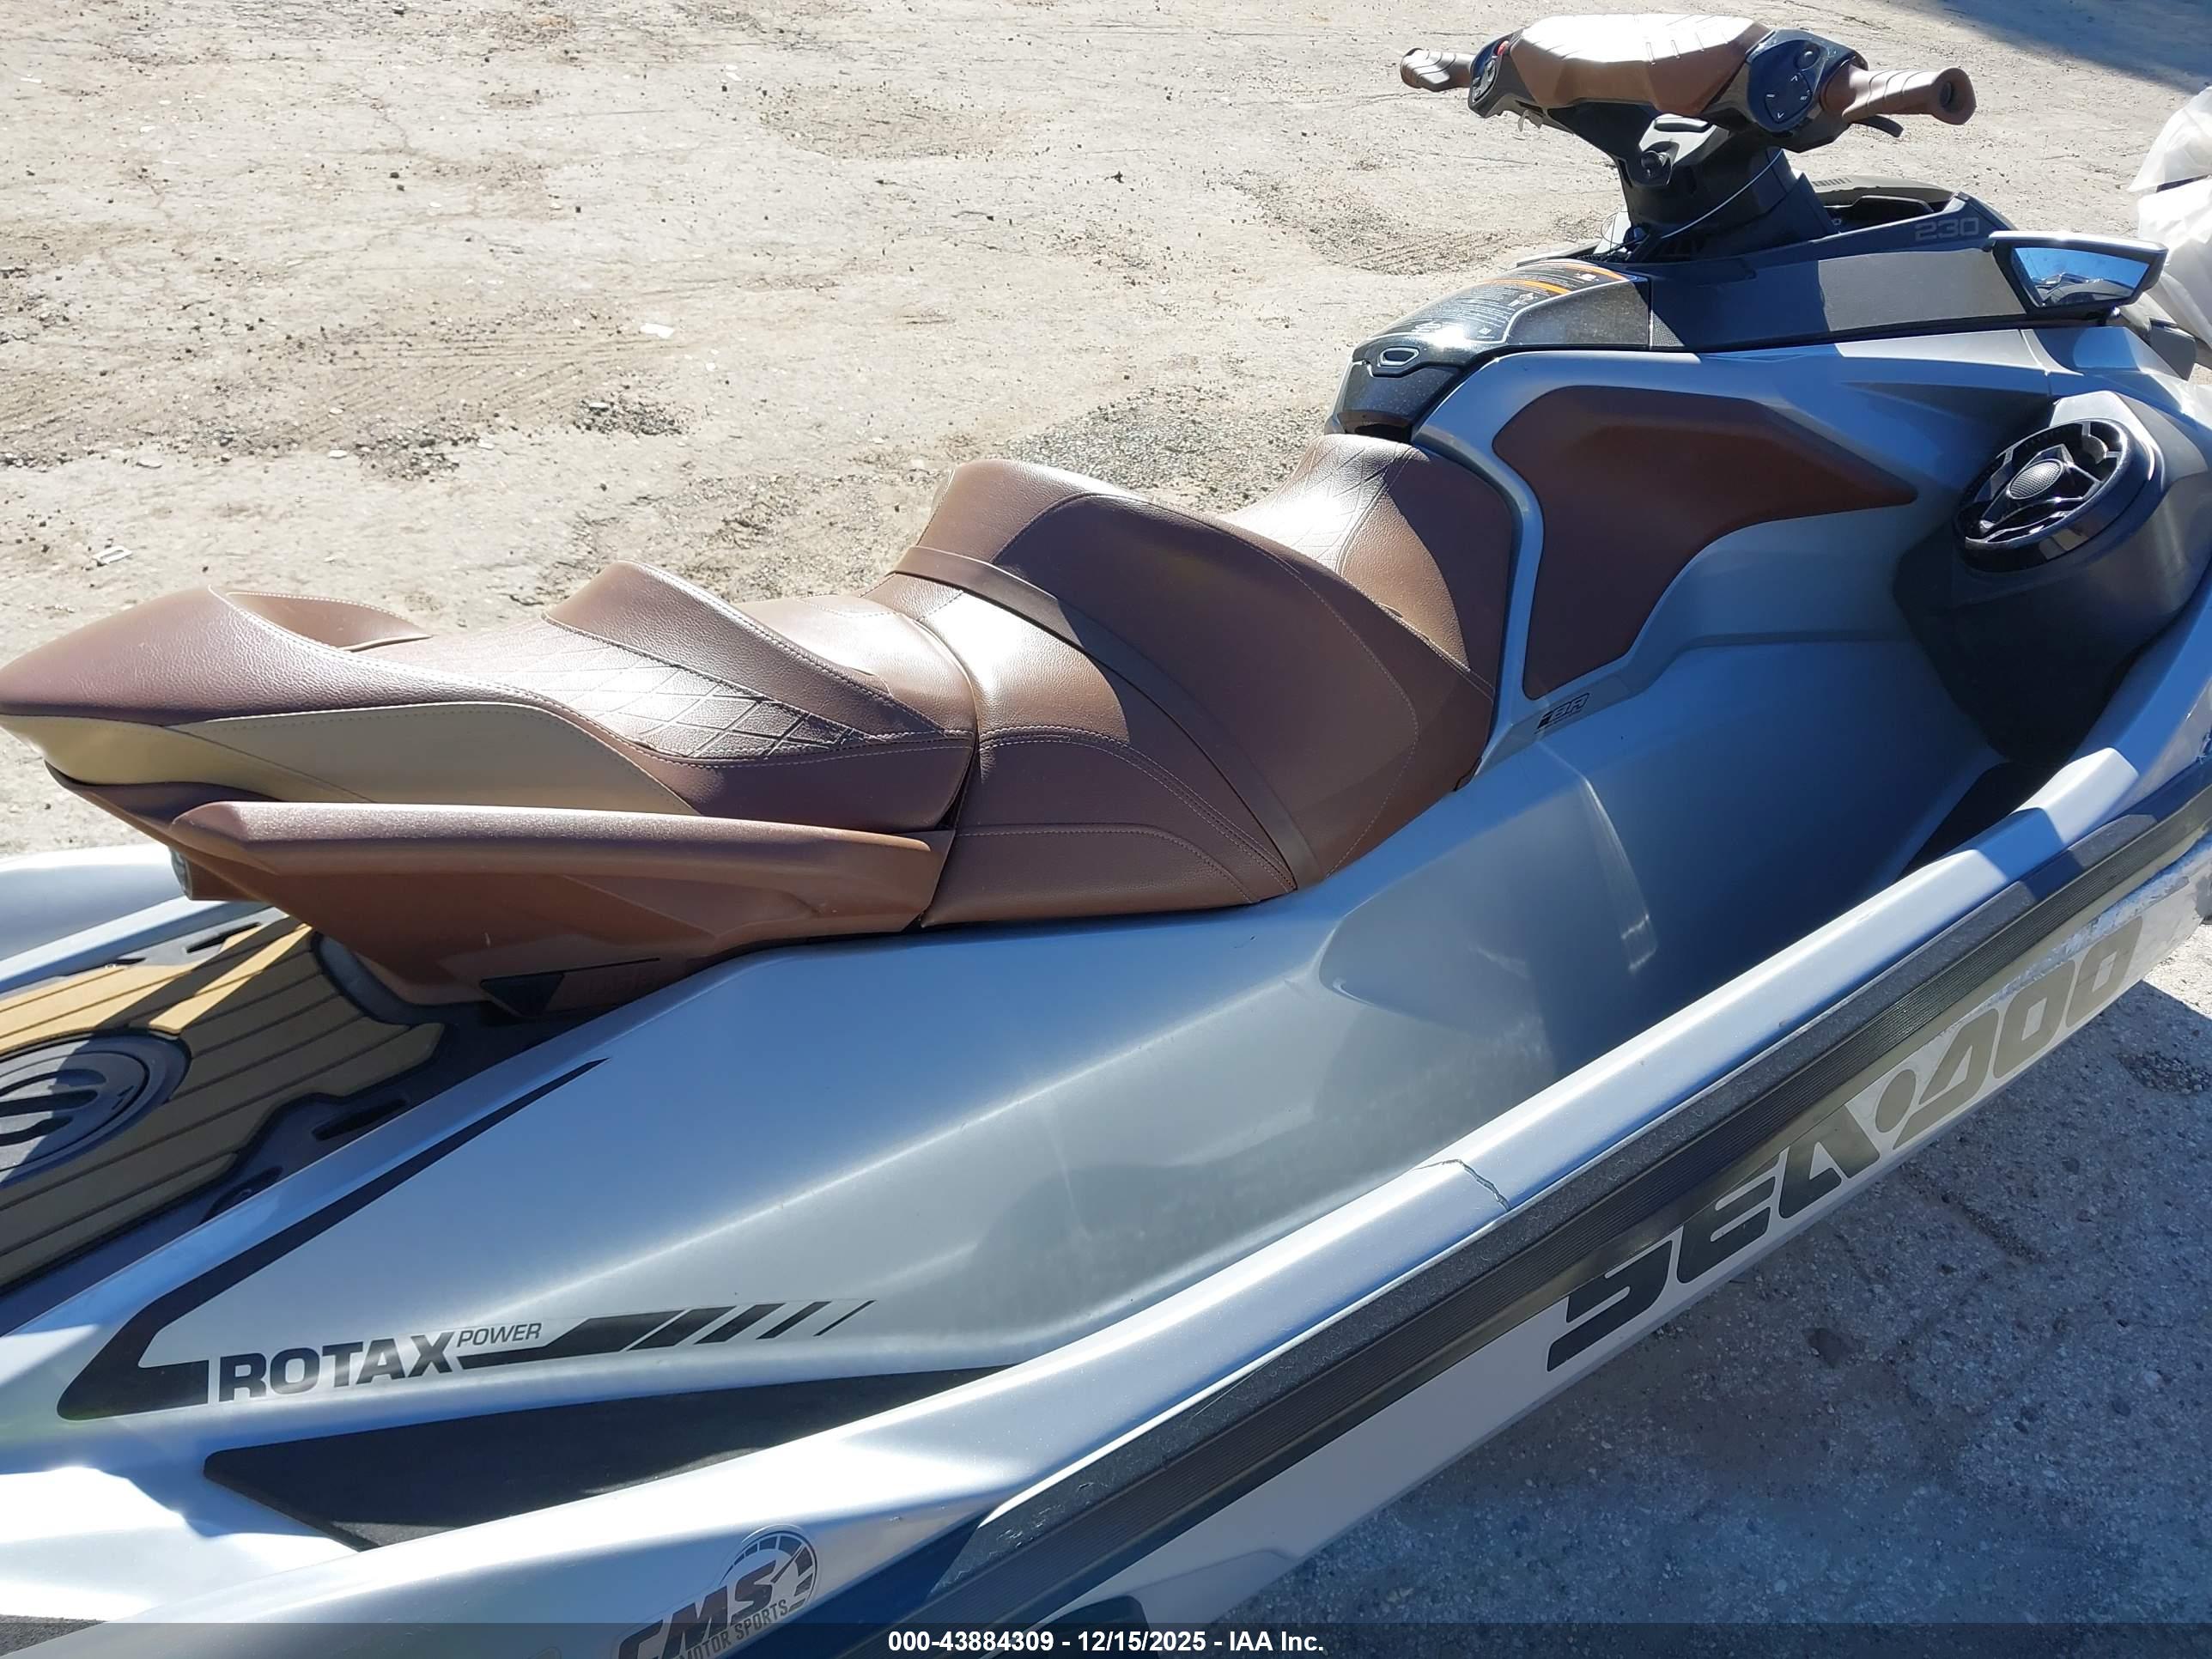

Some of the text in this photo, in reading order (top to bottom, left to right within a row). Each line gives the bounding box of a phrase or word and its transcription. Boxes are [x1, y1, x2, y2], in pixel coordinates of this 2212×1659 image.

[1916, 218, 1978, 241] 230
[219, 1322, 542, 1402] ROTAX POWER
[736, 1599, 788, 1640] SPORTS
